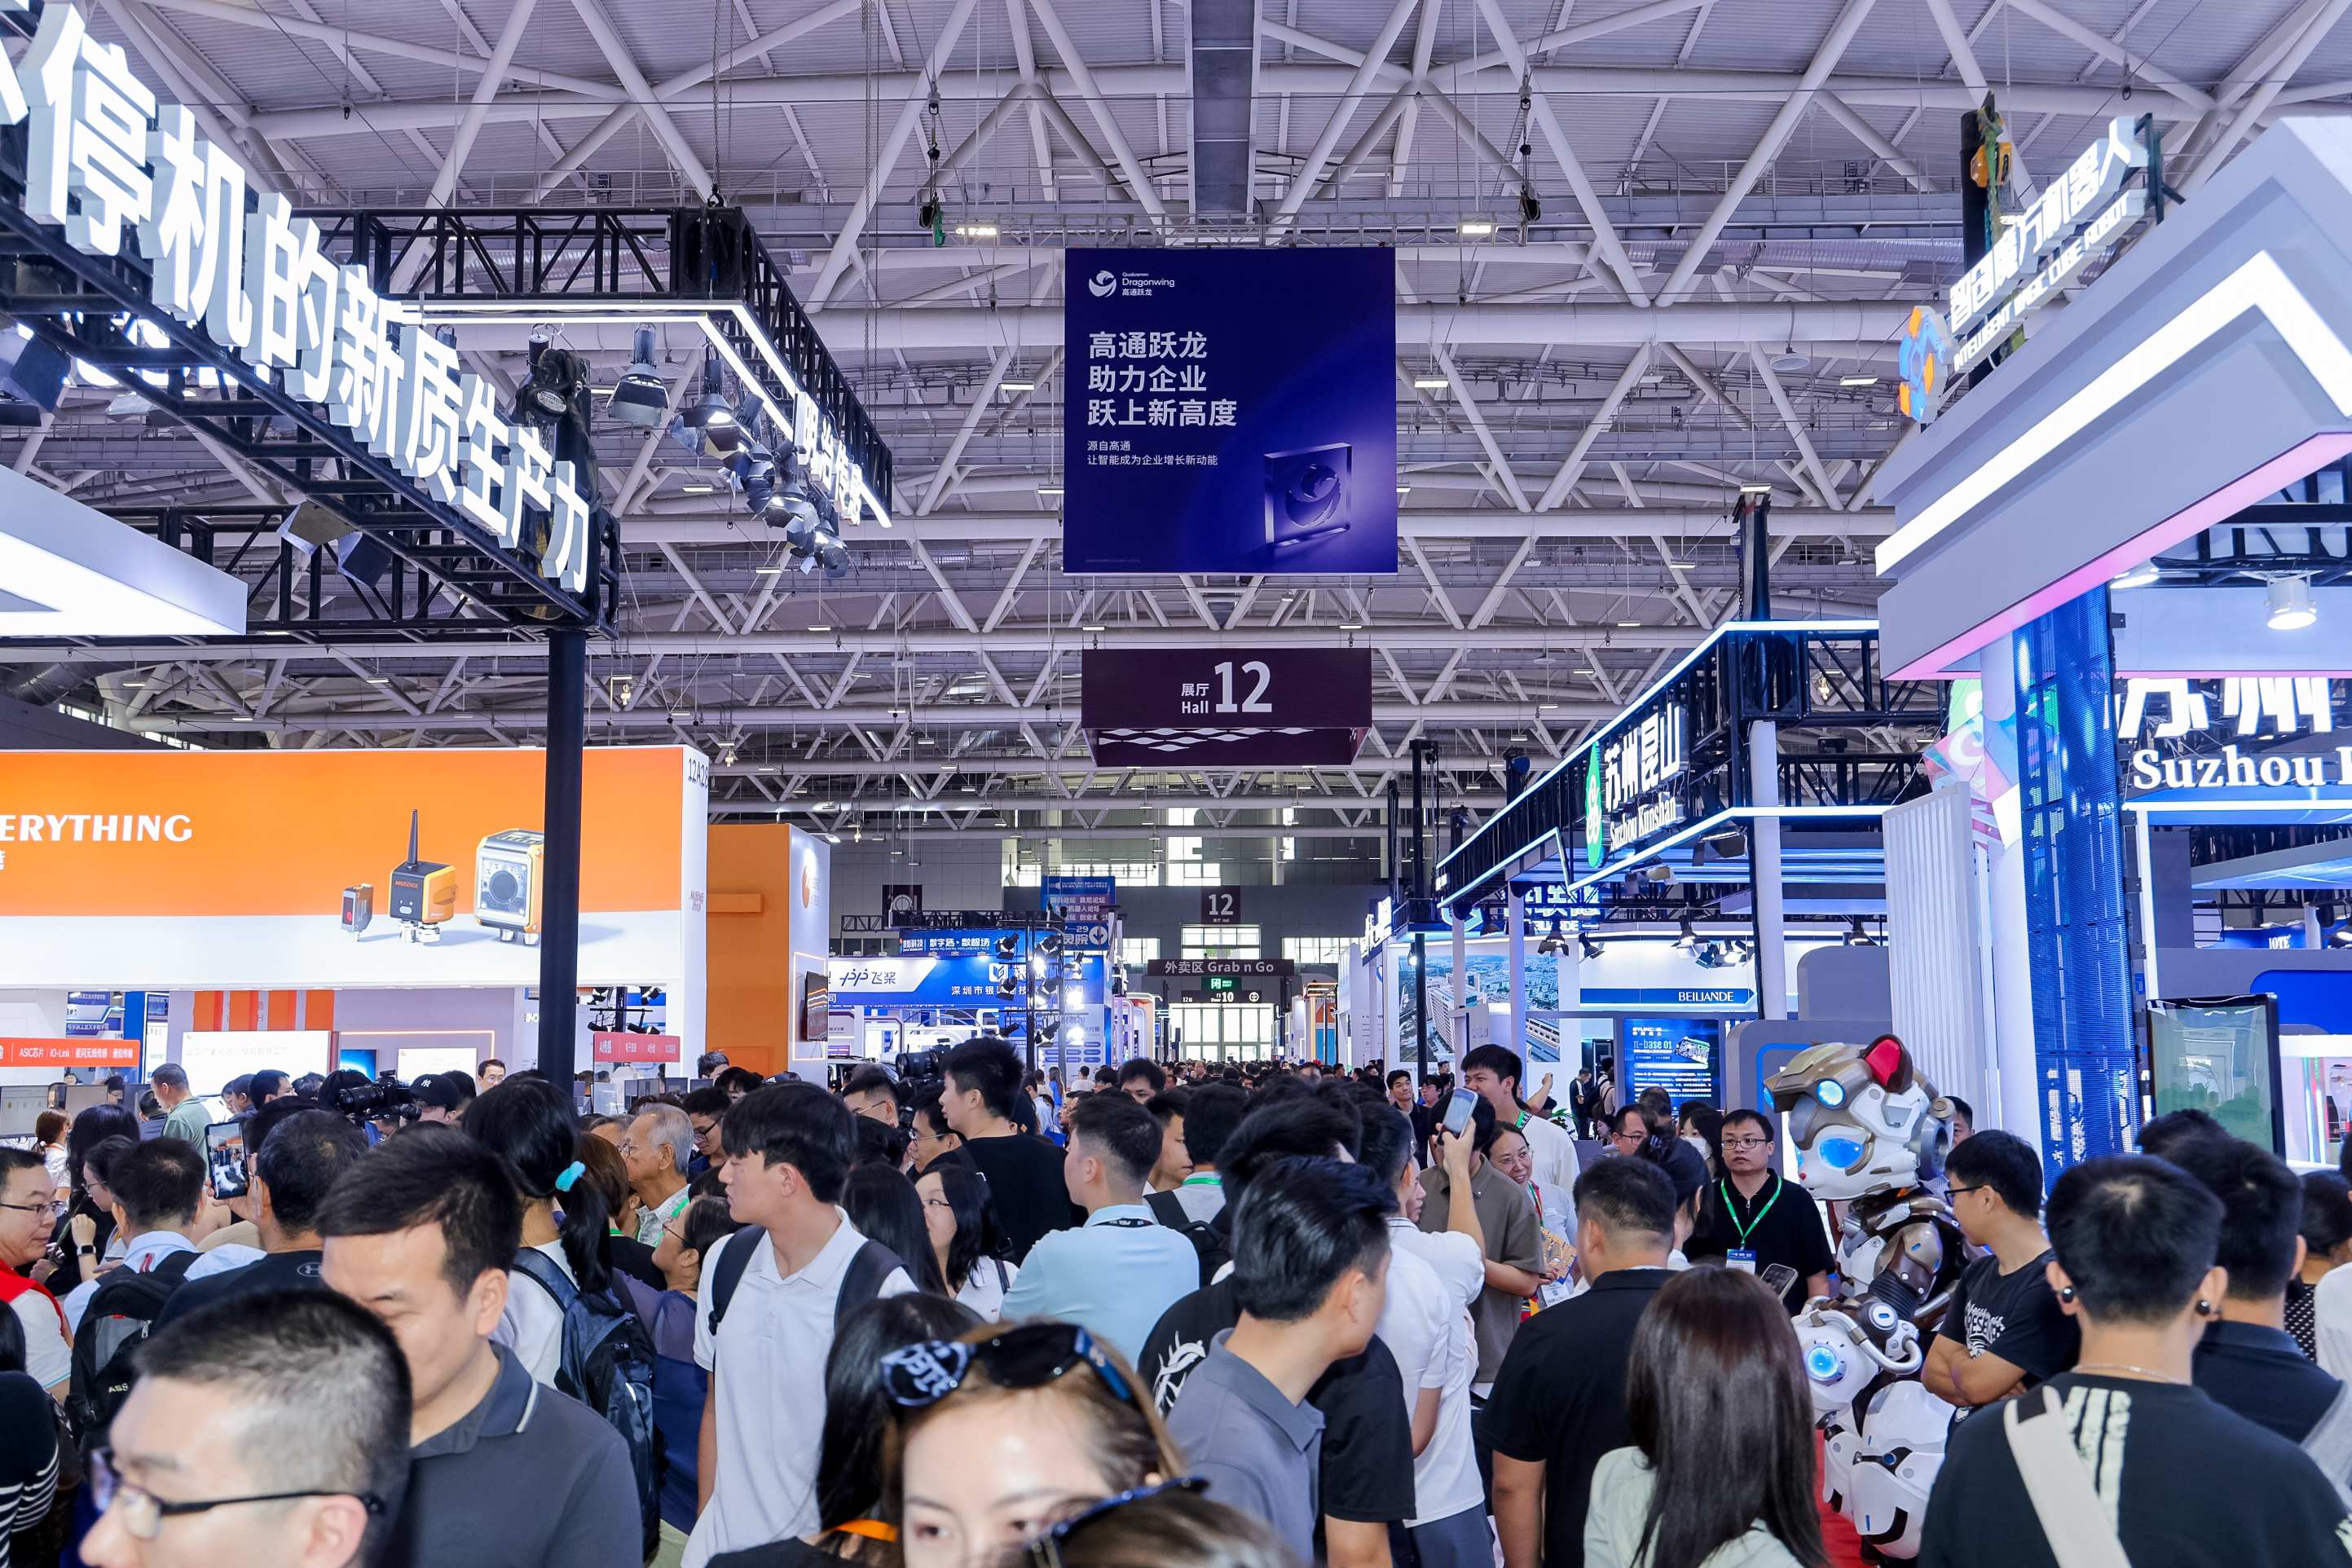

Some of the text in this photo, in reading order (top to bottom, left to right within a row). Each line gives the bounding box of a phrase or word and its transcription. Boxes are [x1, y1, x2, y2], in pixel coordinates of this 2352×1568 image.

[2084, 192, 2129, 249] ROBOT
[1122, 278, 1175, 287] Dragonwing
[0, 0, 589, 593] 停机的新质生产力
[1089, 332, 1207, 359] 高通跃龙
[1089, 365, 1207, 393] 助力企业
[1088, 399, 1237, 427] 跃上新高度
[1087, 441, 1130, 451] 源自高通
[1087, 455, 1218, 465] 让智能成为企业增长新动能
[1182, 684, 1209, 697] 展厅
[1214, 661, 1272, 713] 12
[1182, 701, 1209, 714] Hall
[1604, 702, 1680, 813] 苏州昆山
[2133, 744, 2325, 789] Suzhou
[1610, 795, 1676, 852] Suzhou Kunshan
[1209, 893, 1234, 915] 12
[1165, 961, 1205, 974] 外卖区
[1207, 961, 1274, 972] Grab n Go
[871, 971, 896, 984] 飞桨
[1222, 992, 1234, 1002] 10
[1678, 991, 1734, 1002] BEILIANDE
[1663, 1040, 1672, 1049] 01
[50, 1048, 70, 1058] IO-Link
